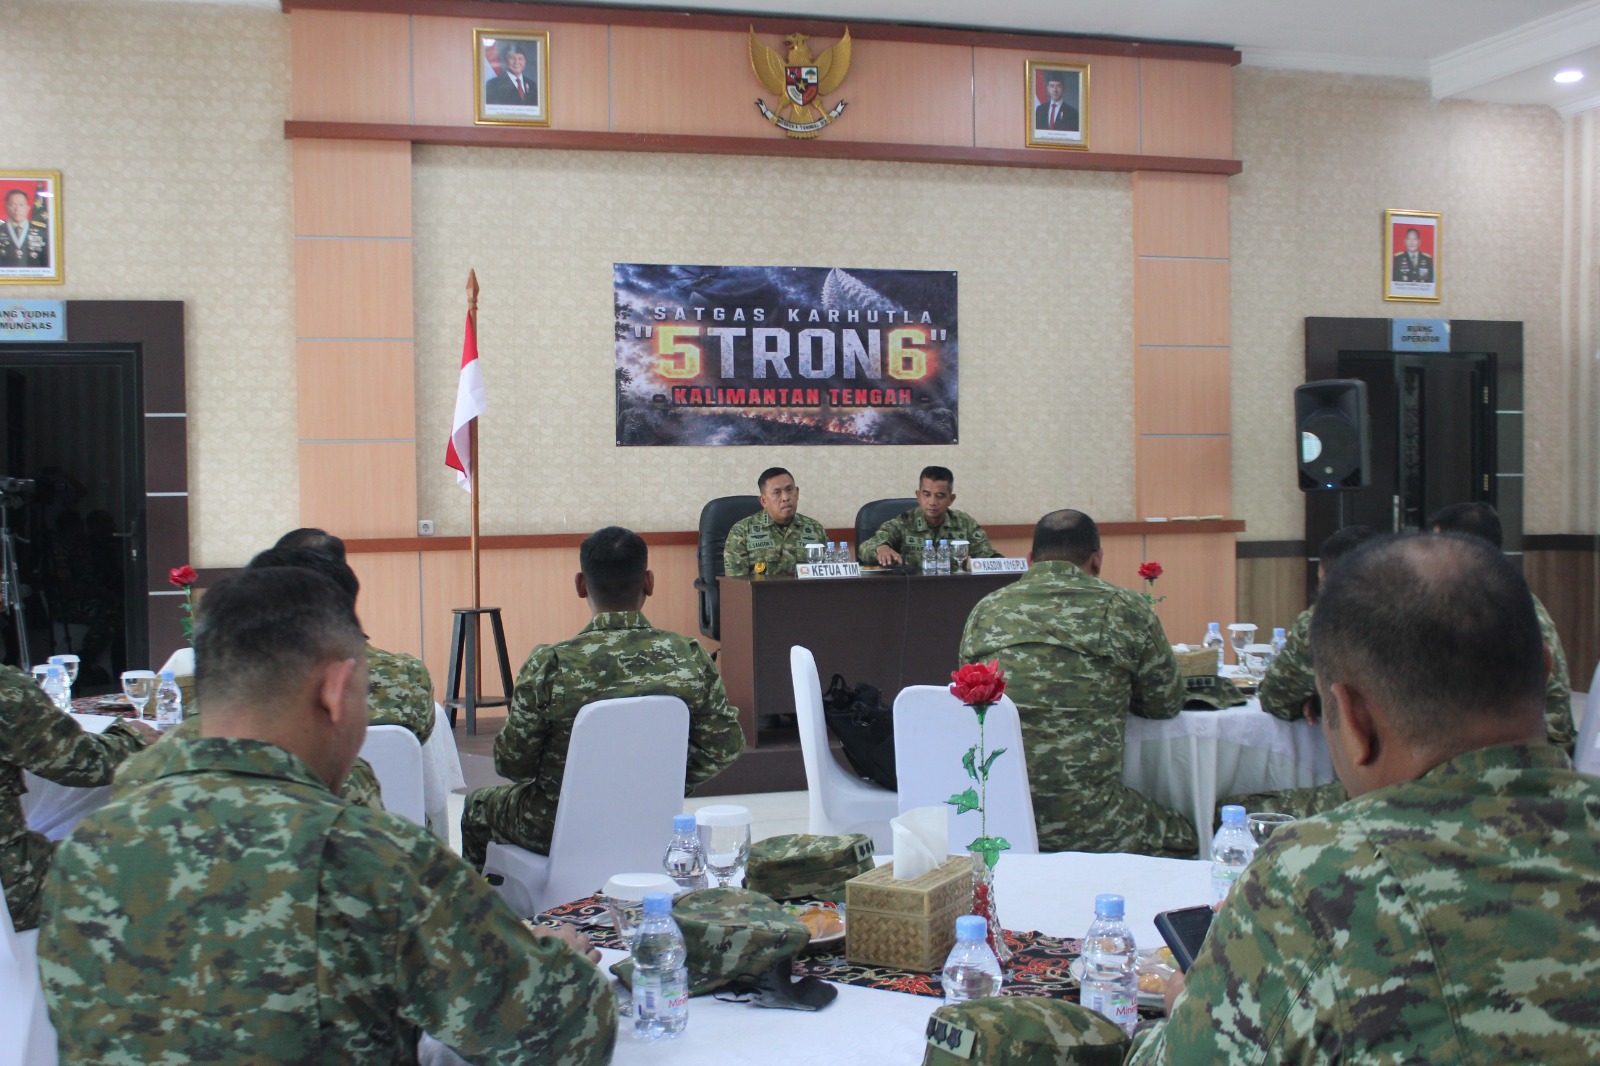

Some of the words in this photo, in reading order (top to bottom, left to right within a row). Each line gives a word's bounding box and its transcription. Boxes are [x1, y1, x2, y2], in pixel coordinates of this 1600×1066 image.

[21, 310, 57, 318] YUDHA
[654, 306, 766, 322] SATGAS
[788, 308, 933, 324] KARHUTLA
[1407, 325, 1433, 333] RUANG
[1401, 335, 1441, 343] OPERATOR
[674, 388, 820, 405] KALIMANTAN
[829, 388, 912, 405] TENGAH
[811, 564, 842, 577] KETUA
[844, 563, 860, 575] TIM
